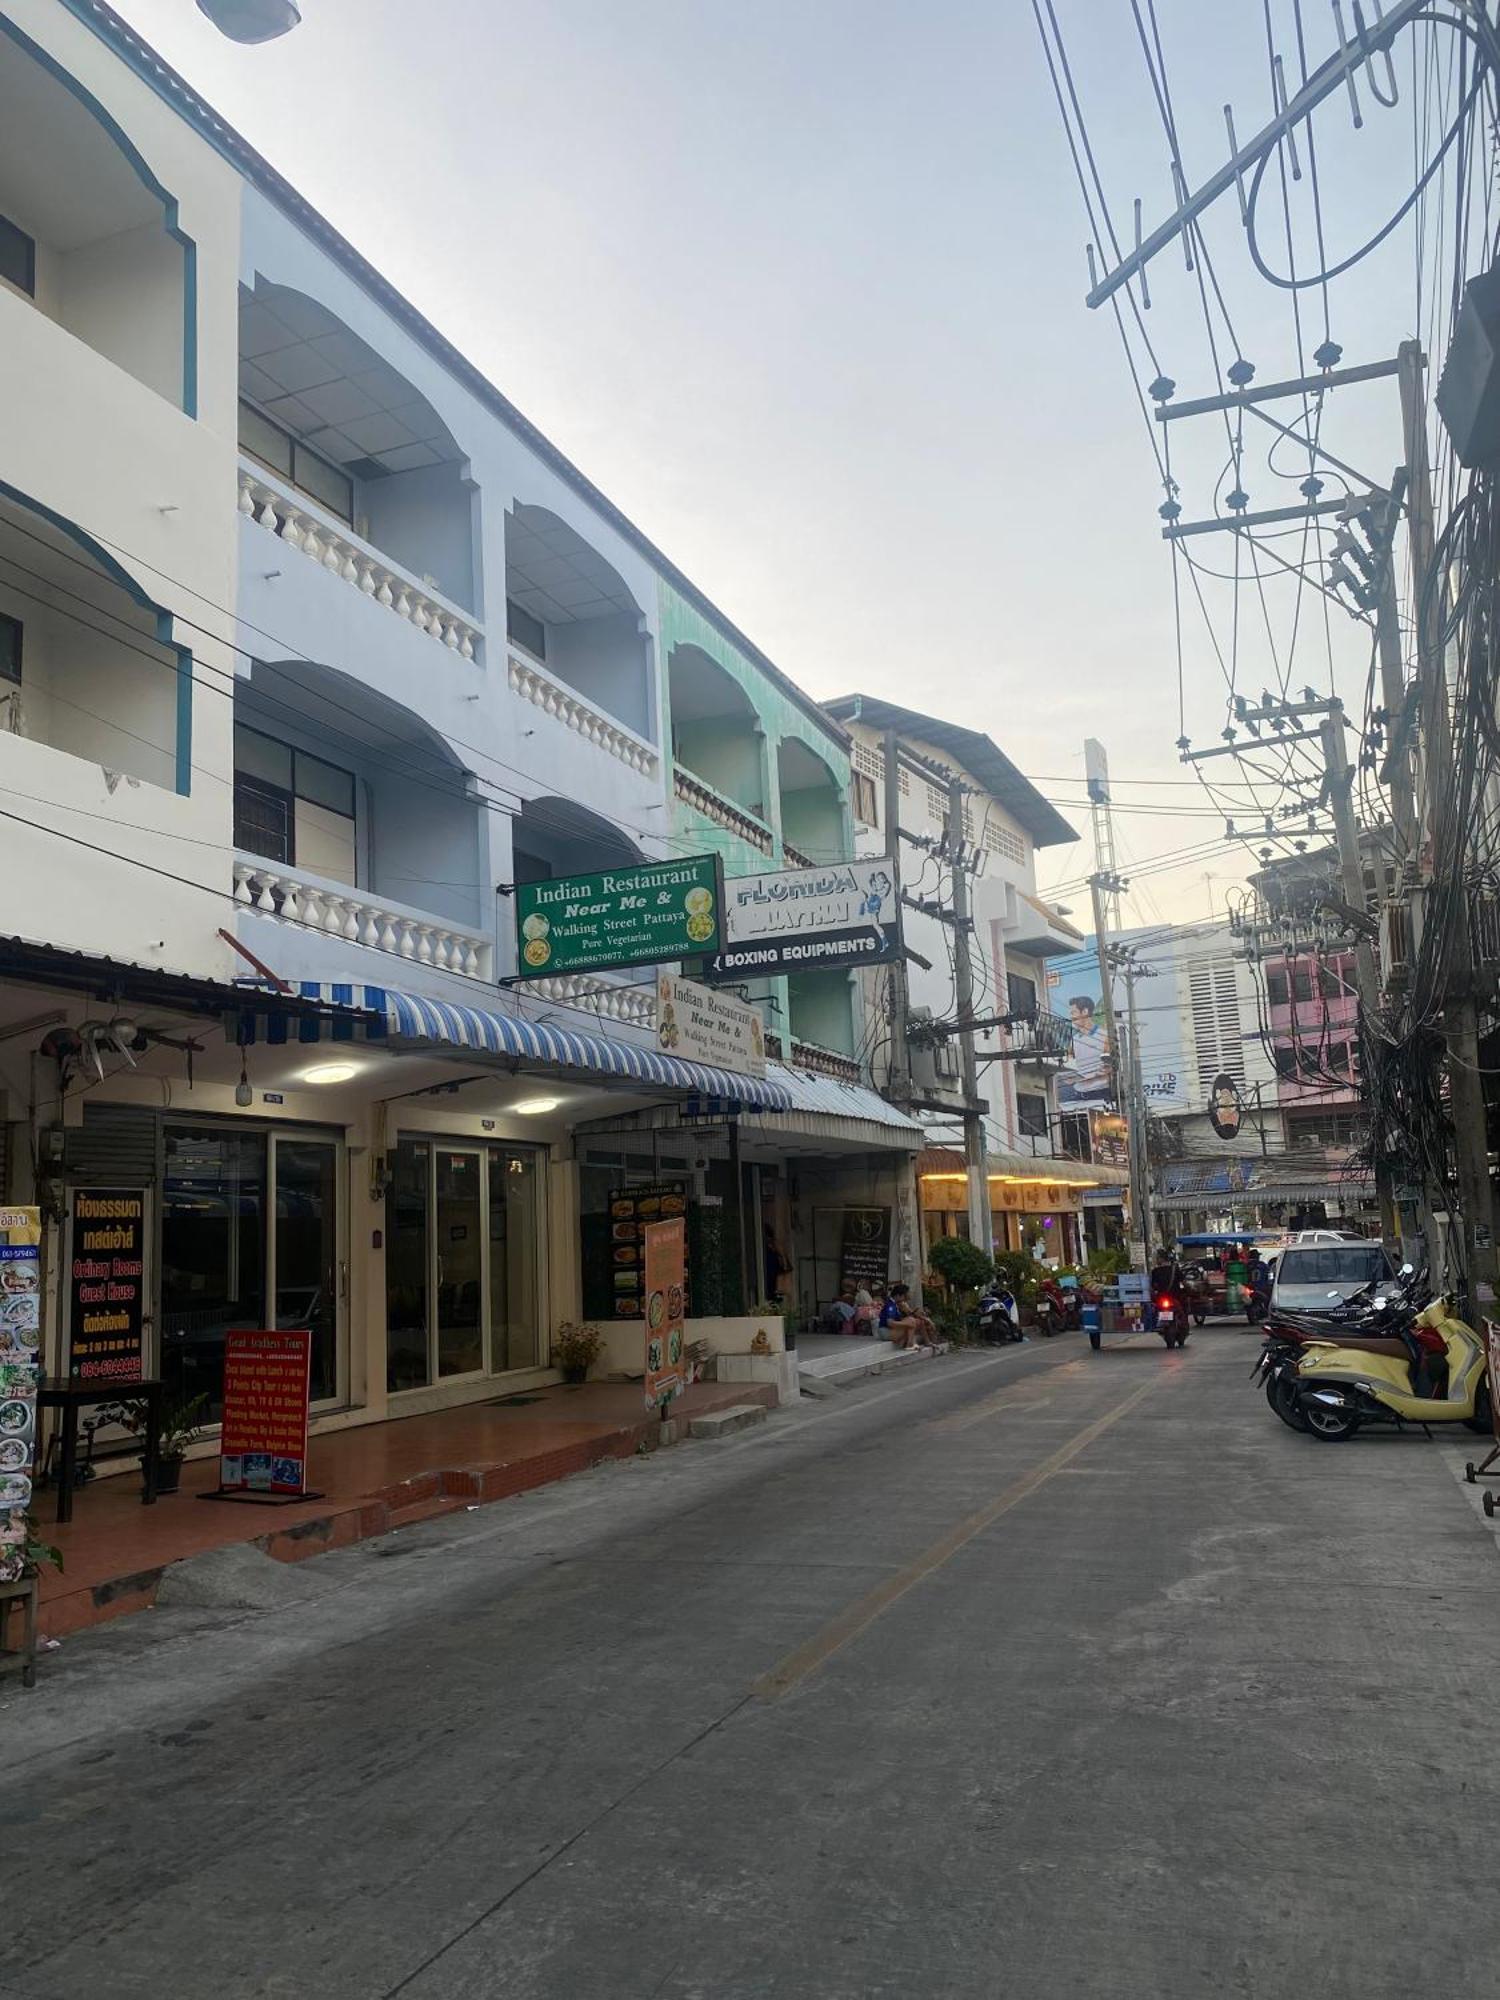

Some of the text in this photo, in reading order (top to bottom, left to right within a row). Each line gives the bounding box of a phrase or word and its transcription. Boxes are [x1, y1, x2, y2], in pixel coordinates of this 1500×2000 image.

[535, 866, 699, 904] Indian Restaurant
[737, 868, 859, 906] FLORIDA
[564, 891, 672, 918] Near Me &
[552, 910, 686, 938] Walking Street Pattaya
[582, 931, 652, 949] Pure Vegetarian
[725, 937, 876, 967] BOXING EQUIPMENTS
[673, 984, 704, 1008] Indian
[707, 996, 750, 1025] Restaurant
[691, 1012, 714, 1028] Near
[718, 1021, 730, 1034] Me
[73, 1257, 142, 1280] Ordinary Rooms
[79, 1282, 136, 1303] Guest House
